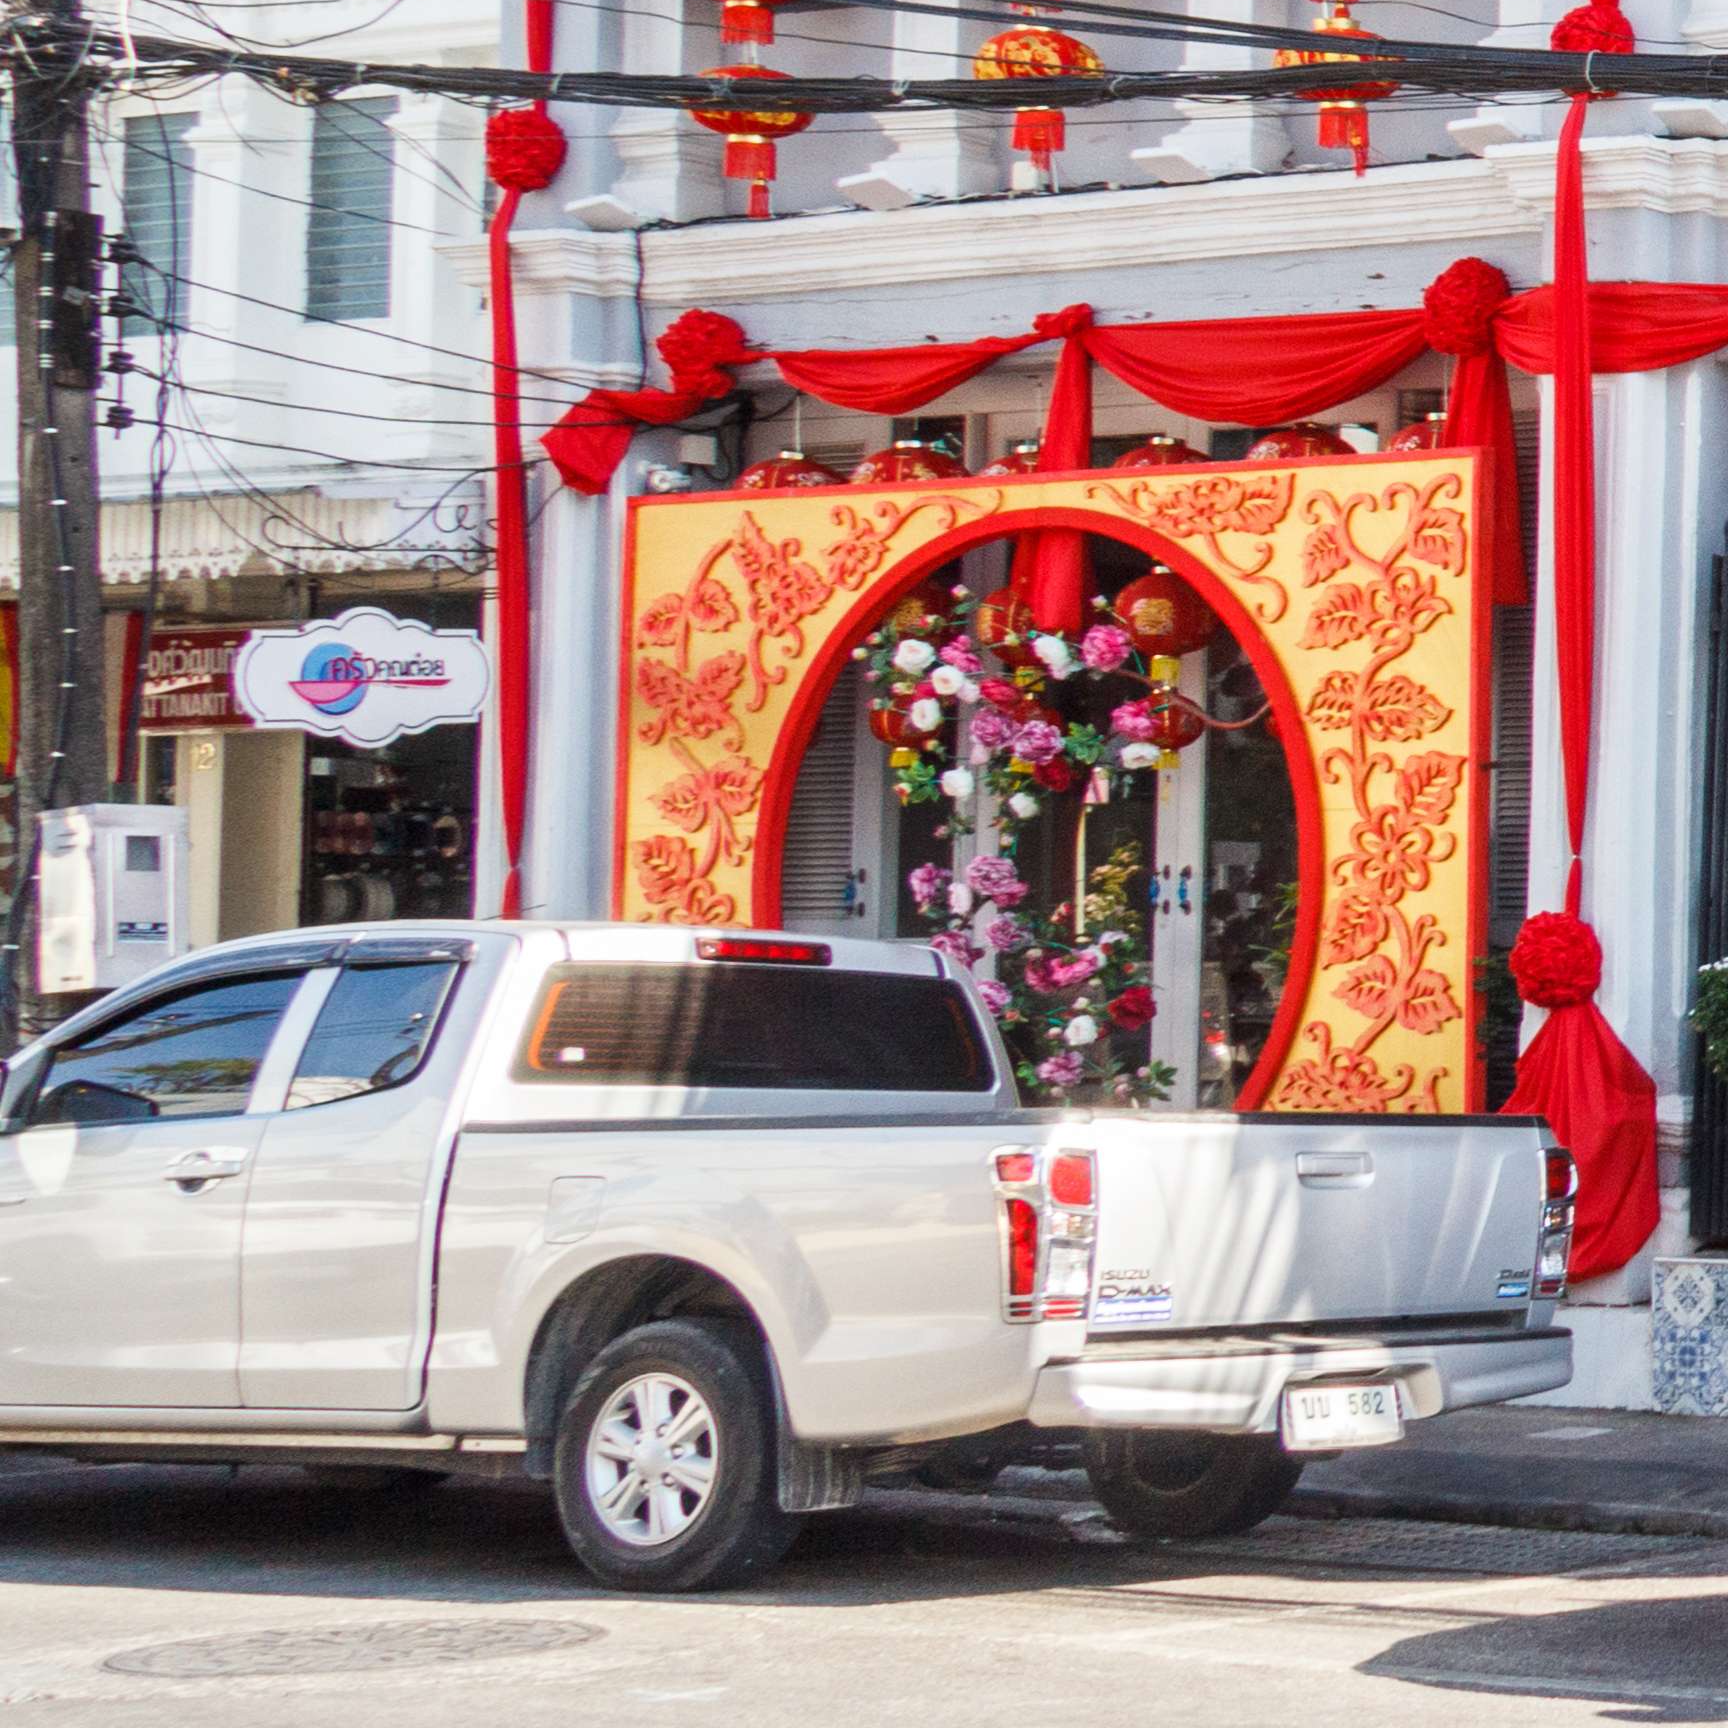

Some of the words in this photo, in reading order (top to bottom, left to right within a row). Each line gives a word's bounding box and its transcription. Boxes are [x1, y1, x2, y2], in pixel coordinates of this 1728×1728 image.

[1100, 1268, 1150, 1281] ISUZU
[1098, 1284, 1171, 1299] D-MAX
[1347, 1390, 1385, 1416] 582
